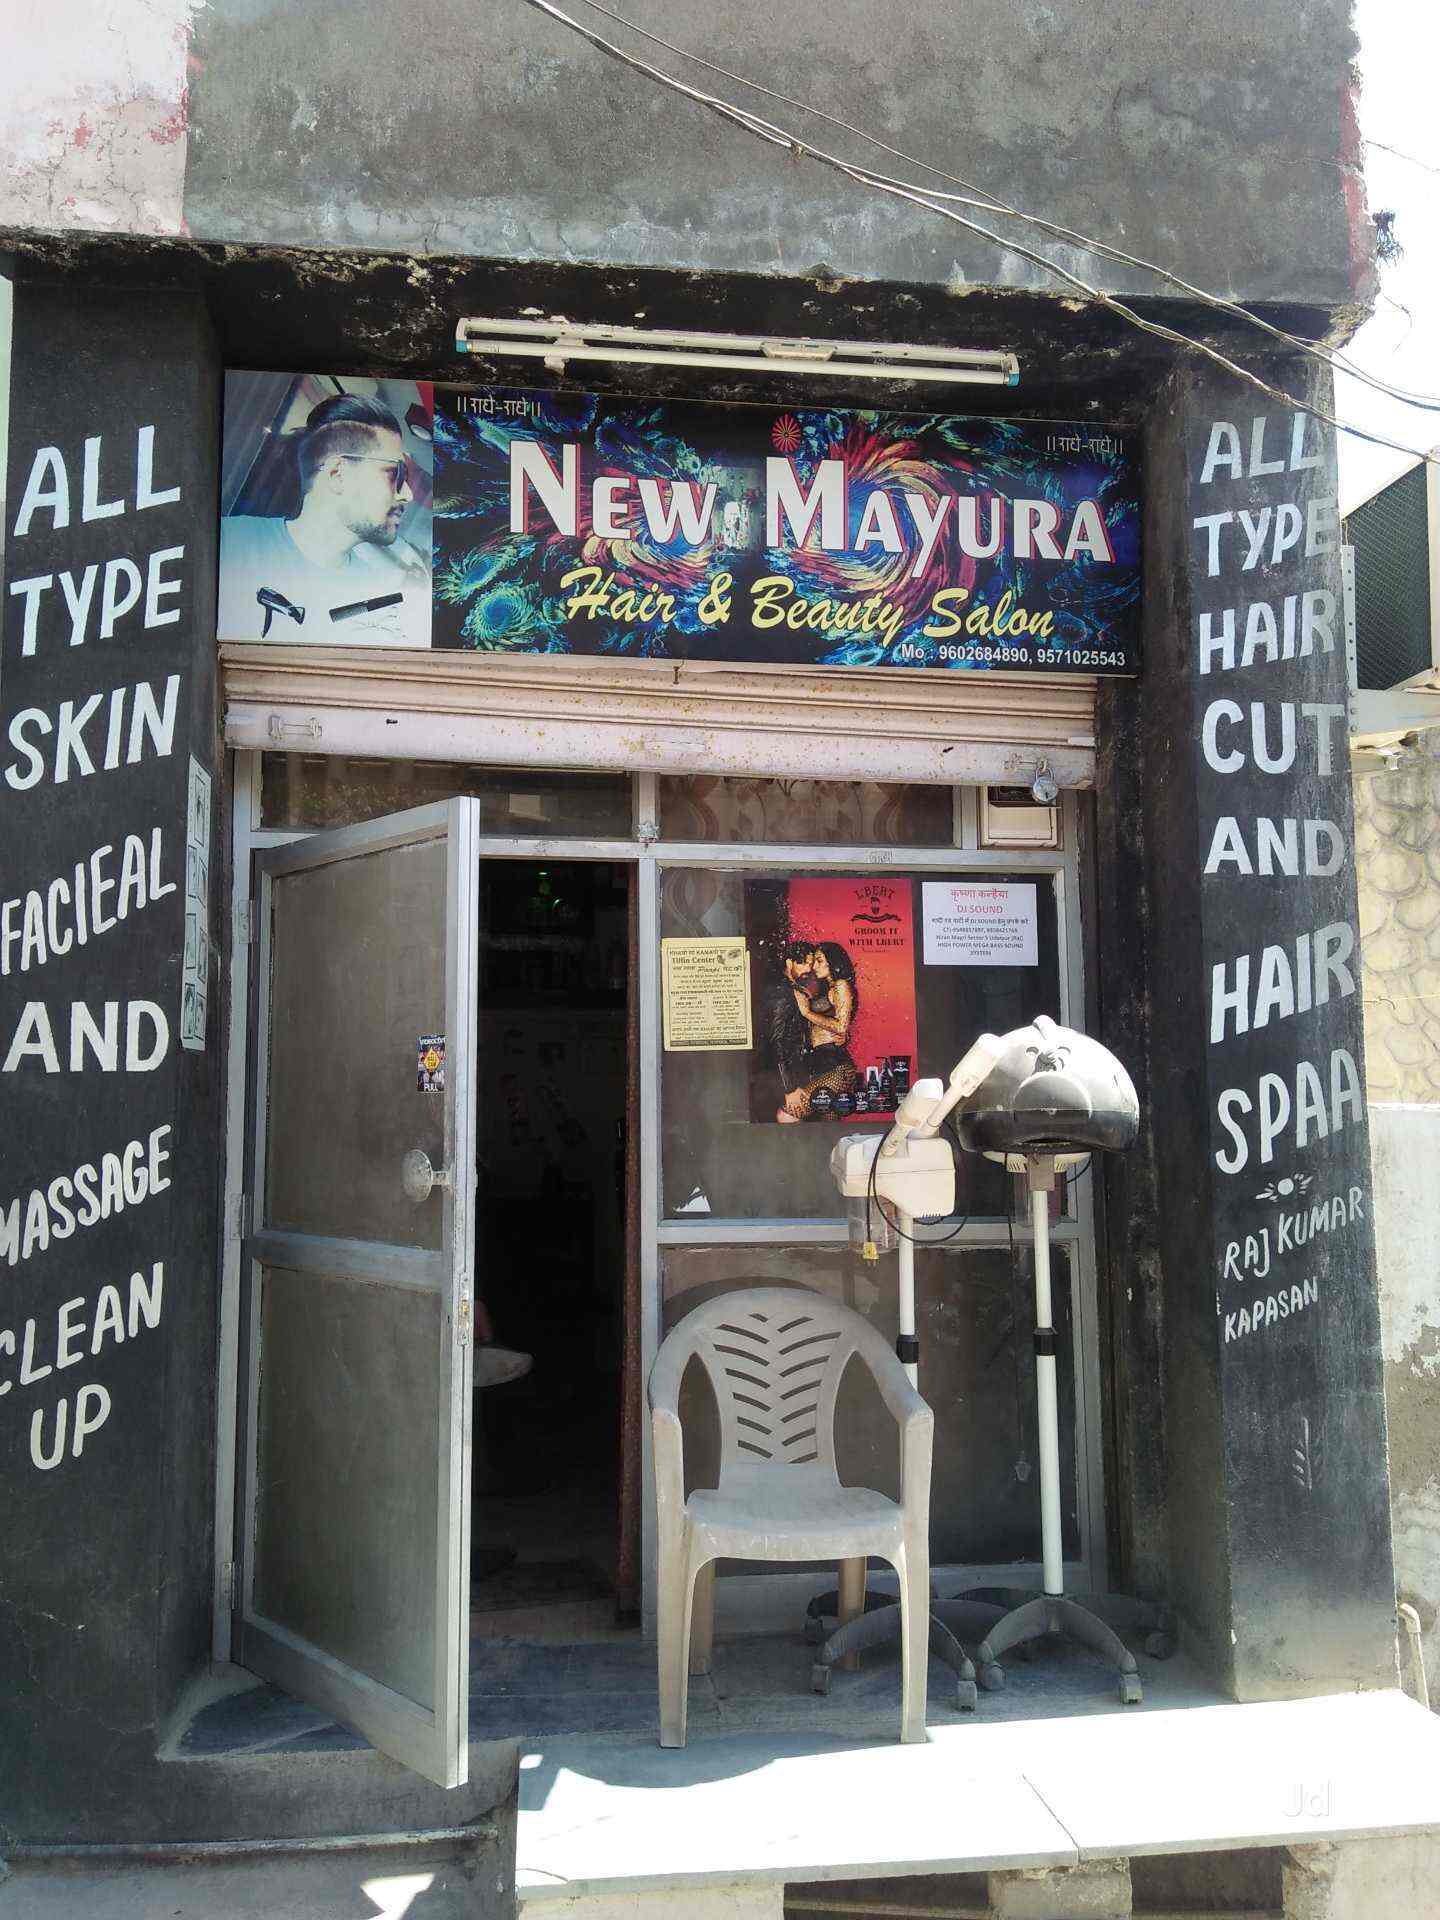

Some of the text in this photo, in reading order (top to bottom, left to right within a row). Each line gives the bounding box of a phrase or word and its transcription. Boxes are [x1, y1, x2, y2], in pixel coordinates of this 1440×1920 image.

[14, 425, 181, 536] ALL
[1200, 411, 1326, 484] ALL
[510, 440, 1116, 578] NEW MAYURA
[1194, 497, 1339, 577] TYPE
[10, 544, 185, 656] TYPE
[560, 566, 1054, 646] Hair & Beauty Salon
[1199, 589, 1337, 675] HAIR
[939, 646, 1032, 664] 9602684890,
[1037, 649, 1125, 666] 9571025543
[5, 674, 180, 791] SKIN
[1202, 698, 1346, 776] CUT
[1203, 816, 1345, 877] AND
[1, 827, 176, 975] FACIEAL
[854, 927, 886, 935] GROOM
[956, 905, 1004, 914] DJ SOUND
[1210, 921, 1356, 1044] HAIR
[2, 1000, 169, 1072] AND
[1215, 1047, 1363, 1174] SPAA
[1224, 1186, 1364, 1281] RAJ KUMAR
[1225, 1276, 1318, 1343] KAPASAN
[31, 1384, 112, 1470] UP
